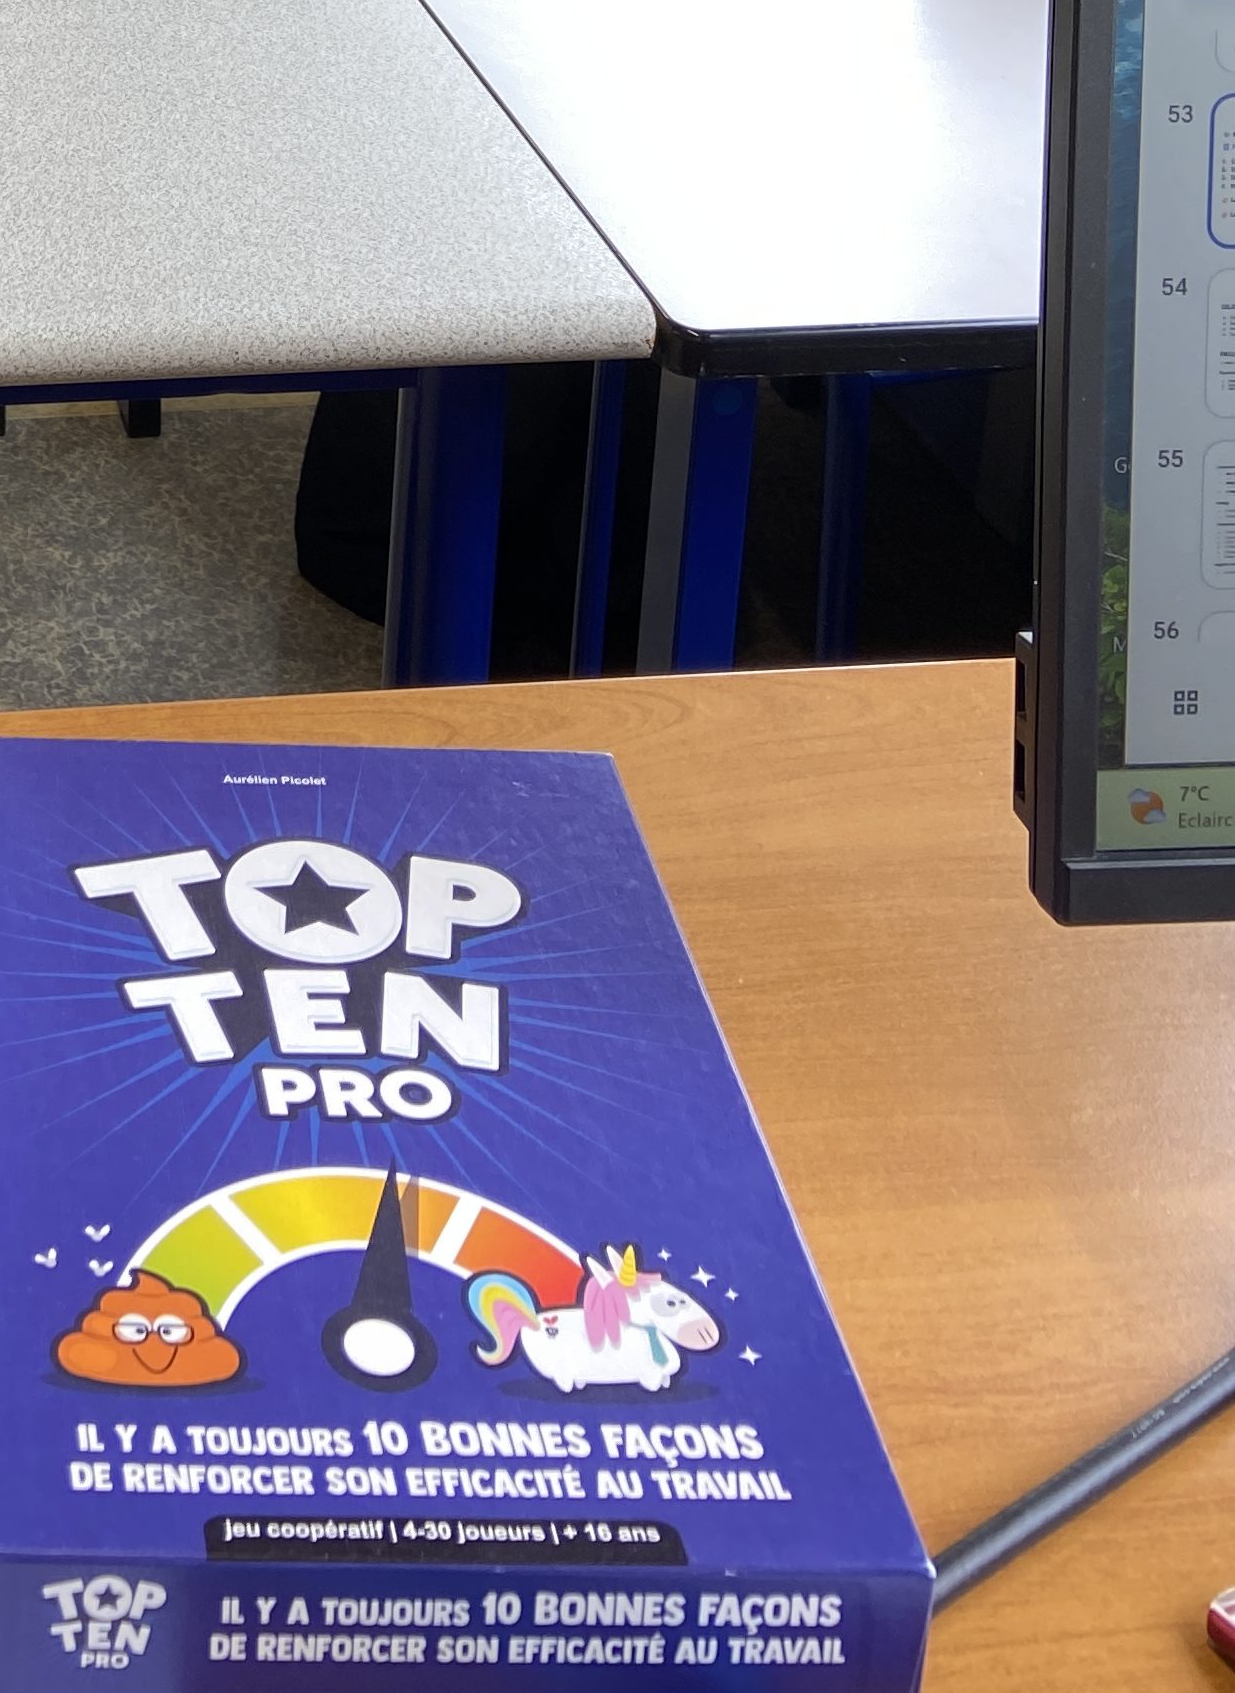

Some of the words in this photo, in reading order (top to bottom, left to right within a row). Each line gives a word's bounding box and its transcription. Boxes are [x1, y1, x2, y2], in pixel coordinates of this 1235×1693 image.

[1168, 105, 1193, 123] 53
[1162, 278, 1188, 295] 54
[1158, 450, 1183, 467] 55
[1154, 621, 1179, 639] 56
[223, 774, 278, 785] Aurélien
[281, 775, 326, 786] Picolet
[1180, 786, 1210, 802] 7°C
[74, 840, 522, 964] TOP
[124, 969, 499, 1071] TEN
[261, 1068, 452, 1119] PRO
[78, 1424, 104, 1452] IL
[115, 1424, 137, 1453] Y
[152, 1425, 177, 1454] A
[187, 1426, 353, 1457] TOUJOURS
[364, 1421, 409, 1456] 10
[420, 1421, 591, 1457] BONNES
[600, 1424, 764, 1468] FAÇONS
[70, 1462, 113, 1491] DE
[123, 1463, 315, 1495] RENFORCER
[325, 1467, 398, 1496] SON
[405, 1464, 586, 1498] EFFICACITÉ
[597, 1470, 643, 1499] AU
[651, 1470, 792, 1500] TRAVAIL
[224, 1518, 260, 1542] jeu
[267, 1519, 384, 1542] coopératif
[404, 1520, 451, 1541] 4-30
[458, 1521, 545, 1544] joueurs
[584, 1523, 612, 1542] 16
[617, 1526, 660, 1543] ans
[42, 1574, 167, 1622] TOP
[221, 1596, 244, 1625] IL
[256, 1596, 277, 1625] Y
[287, 1596, 309, 1626] A
[322, 1596, 470, 1627] TOUJOURS
[482, 1590, 521, 1626] 10
[534, 1591, 685, 1627] BONNES
[698, 1593, 842, 1635] FAÇONS
[50, 1620, 151, 1655] TEN
[209, 1634, 246, 1662] DE
[256, 1634, 427, 1663] RENFORCER
[436, 1636, 499, 1664] SON
[508, 1632, 665, 1664] EFFICACITÉ
[674, 1637, 718, 1665] AU
[728, 1637, 845, 1665] TRAVAIL
[80, 1650, 130, 1670] PRO
